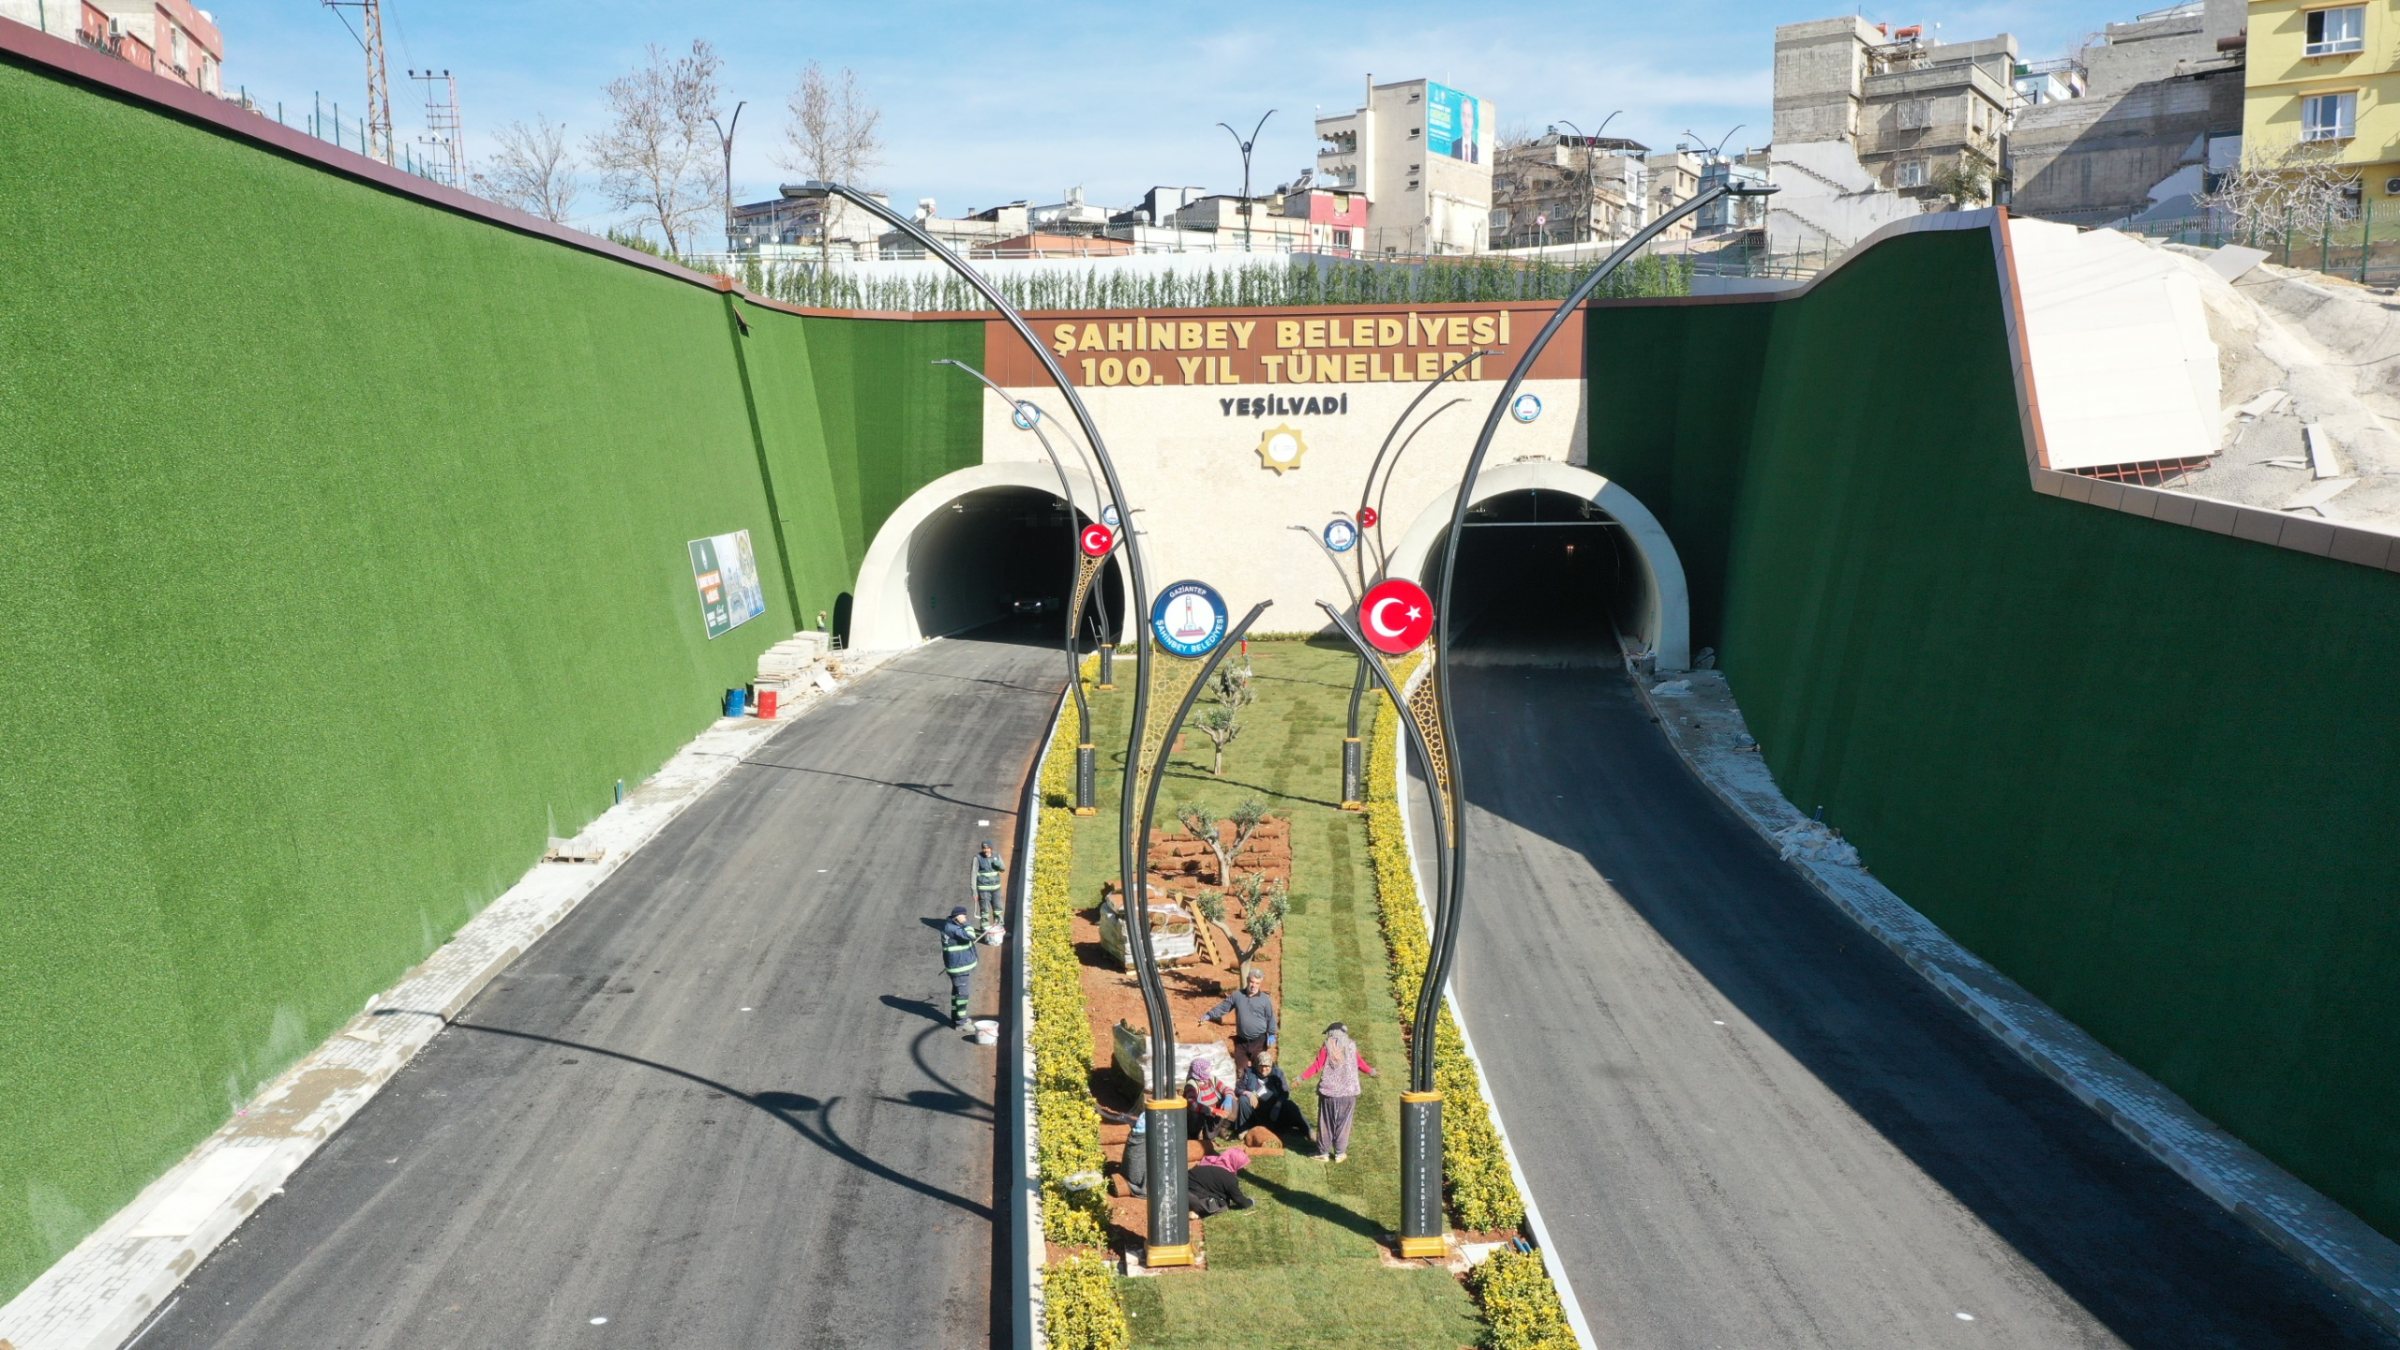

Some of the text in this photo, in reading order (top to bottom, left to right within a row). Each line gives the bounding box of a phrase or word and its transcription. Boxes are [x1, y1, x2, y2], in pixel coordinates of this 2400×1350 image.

[1053, 310, 1510, 358] ŞAHİNBEY BELEDİYESİ
[1081, 346, 1482, 386] 100. YIL TÜNELLERİ
[1218, 392, 1348, 419] YEŞİLVADİ
[1169, 585, 1207, 598] GAZİANTEP
[1155, 619, 1188, 653] ŞAHİNBEY
